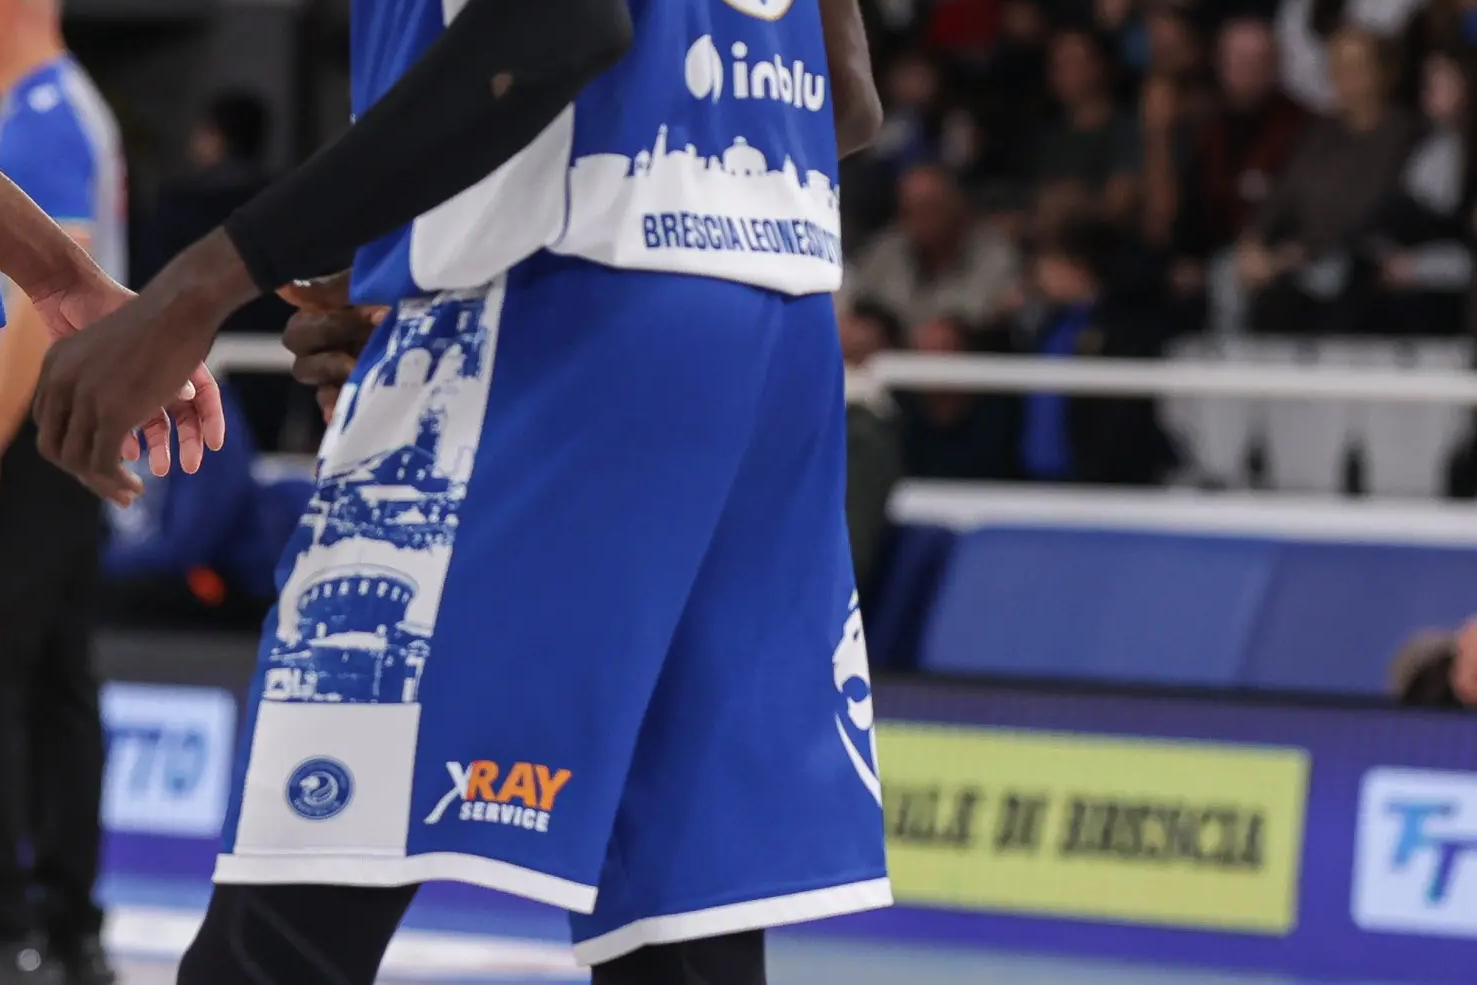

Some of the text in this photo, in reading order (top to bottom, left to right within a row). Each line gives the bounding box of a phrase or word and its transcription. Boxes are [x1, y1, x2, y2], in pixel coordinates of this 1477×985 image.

[730, 40, 825, 113] inblu
[422, 759, 573, 825] XRAY
[458, 801, 551, 833] SERVICE
